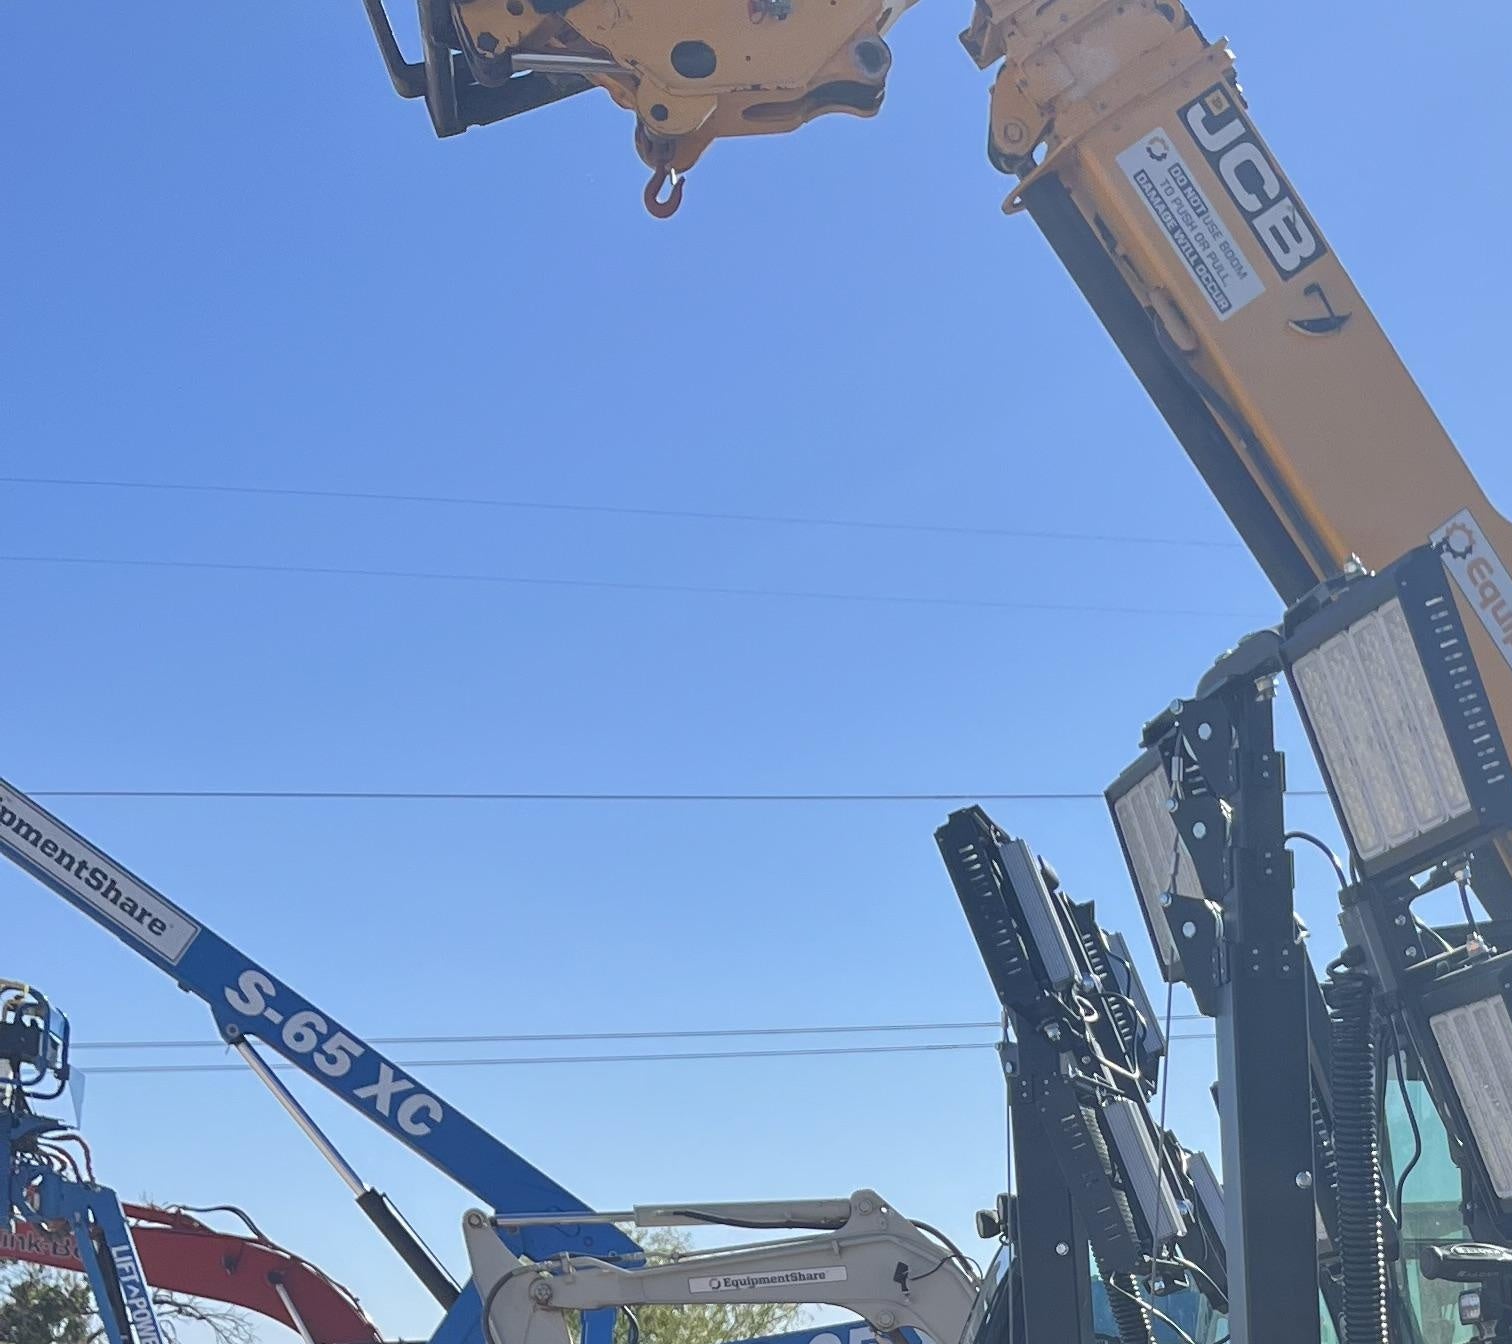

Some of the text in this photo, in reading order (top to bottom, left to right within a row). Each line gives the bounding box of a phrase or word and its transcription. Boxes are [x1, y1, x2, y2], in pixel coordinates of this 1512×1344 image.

[1134, 171, 1230, 311] DAMAGE WILL OCCUR
[1159, 179, 1176, 197] TO
[1170, 196, 1198, 233] PUSH
[1193, 231, 1211, 252] OR
[1169, 164, 1248, 280] DO NOT USE BOOM
[1187, 102, 1317, 272] JCB
[0, 797, 167, 937] pmentShare
[224, 969, 444, 1136] S-65 XC
[723, 1270, 827, 1289] EquipmentShare
